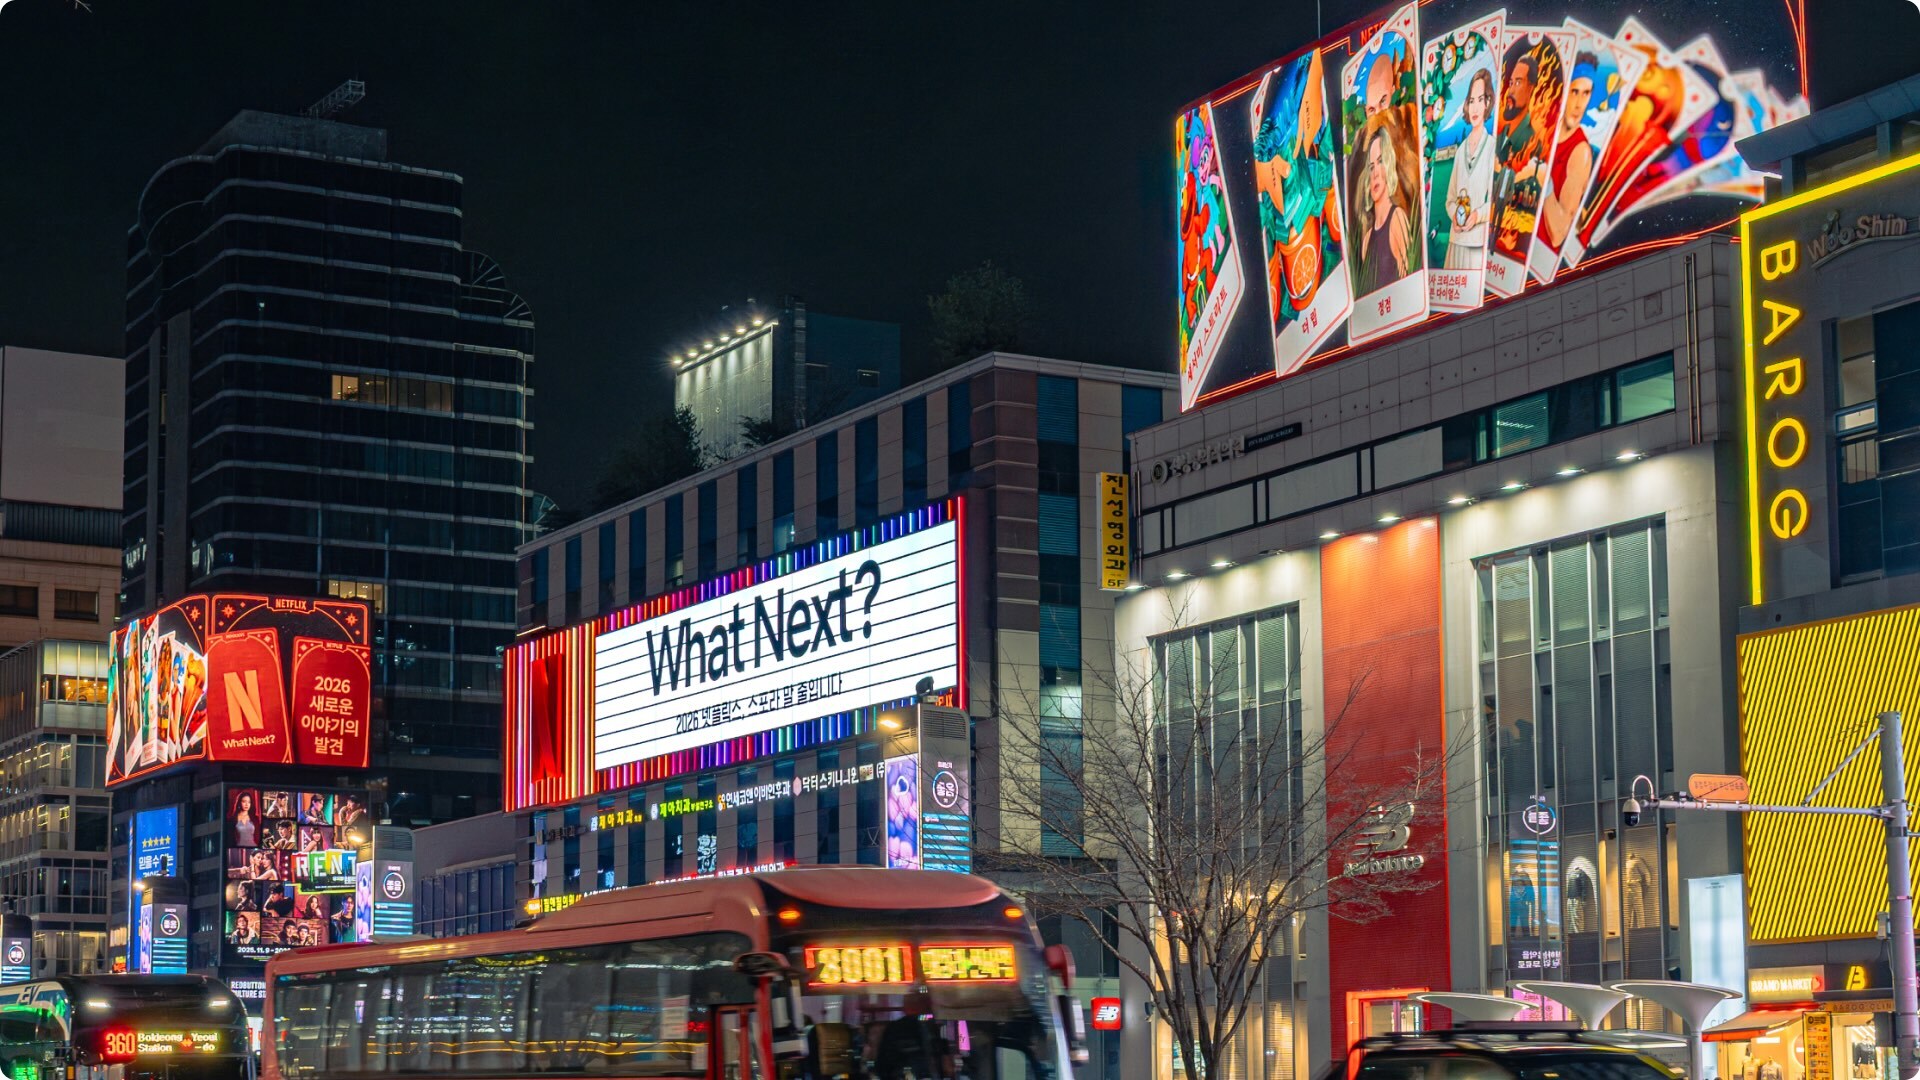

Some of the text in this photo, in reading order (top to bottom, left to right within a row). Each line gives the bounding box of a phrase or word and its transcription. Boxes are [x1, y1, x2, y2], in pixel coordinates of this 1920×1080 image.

[1437, 274, 1467, 287] 크리스티의
[1436, 288, 1460, 301] 다이얼스
[1377, 296, 1392, 316] 정점
[1761, 240, 1808, 540] BAROG
[1105, 474, 1126, 570] 진성형외과
[1107, 578, 1125, 587] 5F
[275, 598, 307, 610] NETFLIX
[646, 559, 882, 697] What Next?
[314, 675, 351, 694] 2026
[223, 669, 264, 733] N
[309, 695, 354, 716] 새로운
[676, 710, 699, 735] 2026
[701, 700, 744, 728] 넷플릭스,
[783, 684, 795, 709] 말
[797, 672, 842, 706] 줄입니다
[301, 714, 359, 738] 이야기의
[222, 734, 276, 749] What Next?
[314, 736, 344, 756] 발견
[295, 855, 357, 878] RENT
[1370, 855, 1425, 874] balance
[230, 981, 266, 990] REDBUTTON
[1751, 976, 1812, 993] BRAND MARKET
[19, 985, 41, 1005] EV
[1833, 1002, 1864, 1012] BAROG
[106, 1032, 135, 1054] 360
[191, 1031, 218, 1043] Yeoui
[137, 1042, 172, 1052] Station
